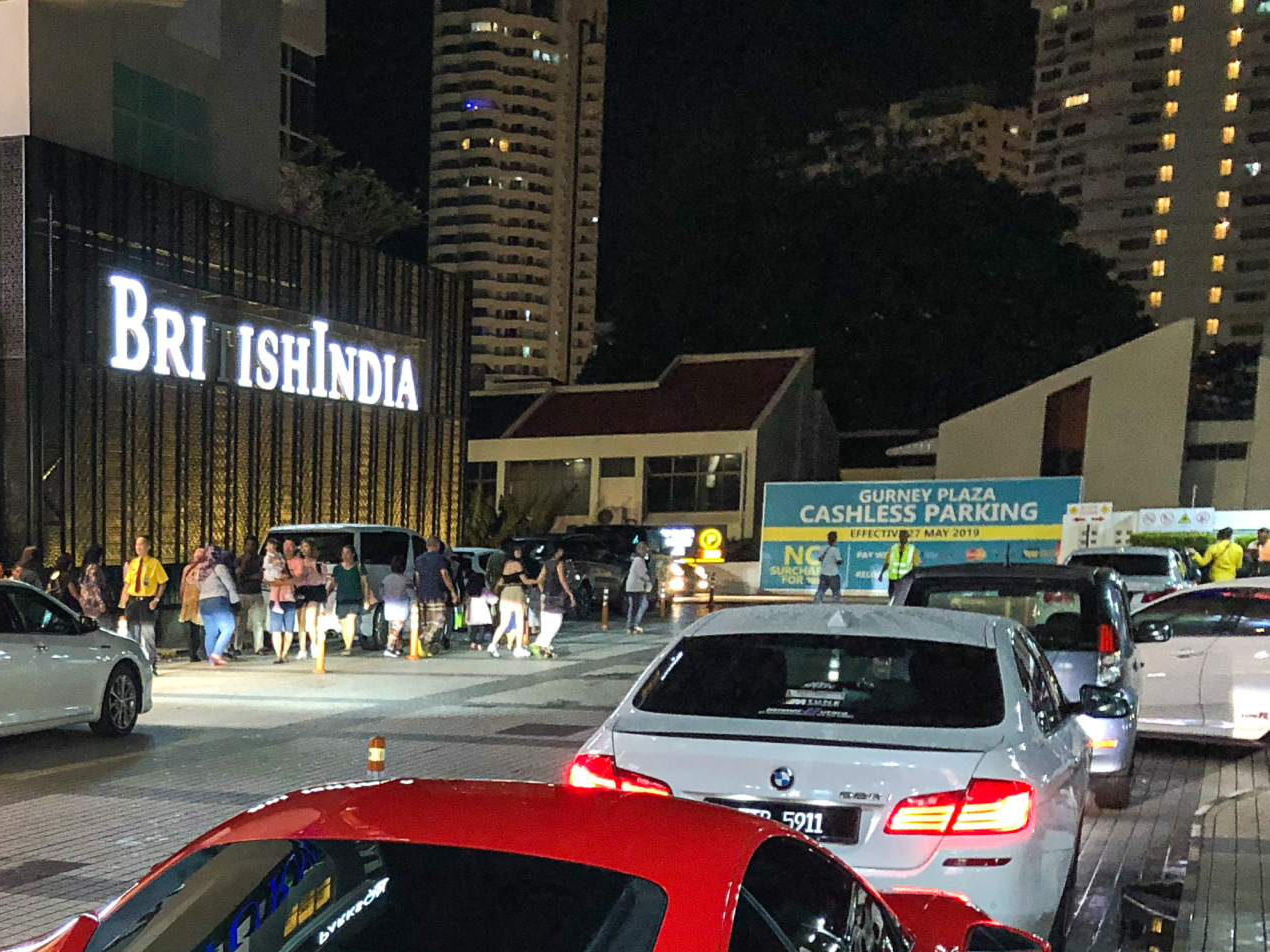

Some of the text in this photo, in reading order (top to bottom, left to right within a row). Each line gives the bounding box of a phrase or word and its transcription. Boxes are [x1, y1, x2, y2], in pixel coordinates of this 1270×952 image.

[859, 486, 996, 504] GURNEY PLAZA
[800, 501, 1038, 524] CASHLESS PARKING
[850, 529, 900, 538] EFFECTIV
[924, 528, 949, 538] MAY
[952, 527, 980, 538] 2019
[781, 575, 804, 585] FOR
[782, 811, 823, 834] 5911
